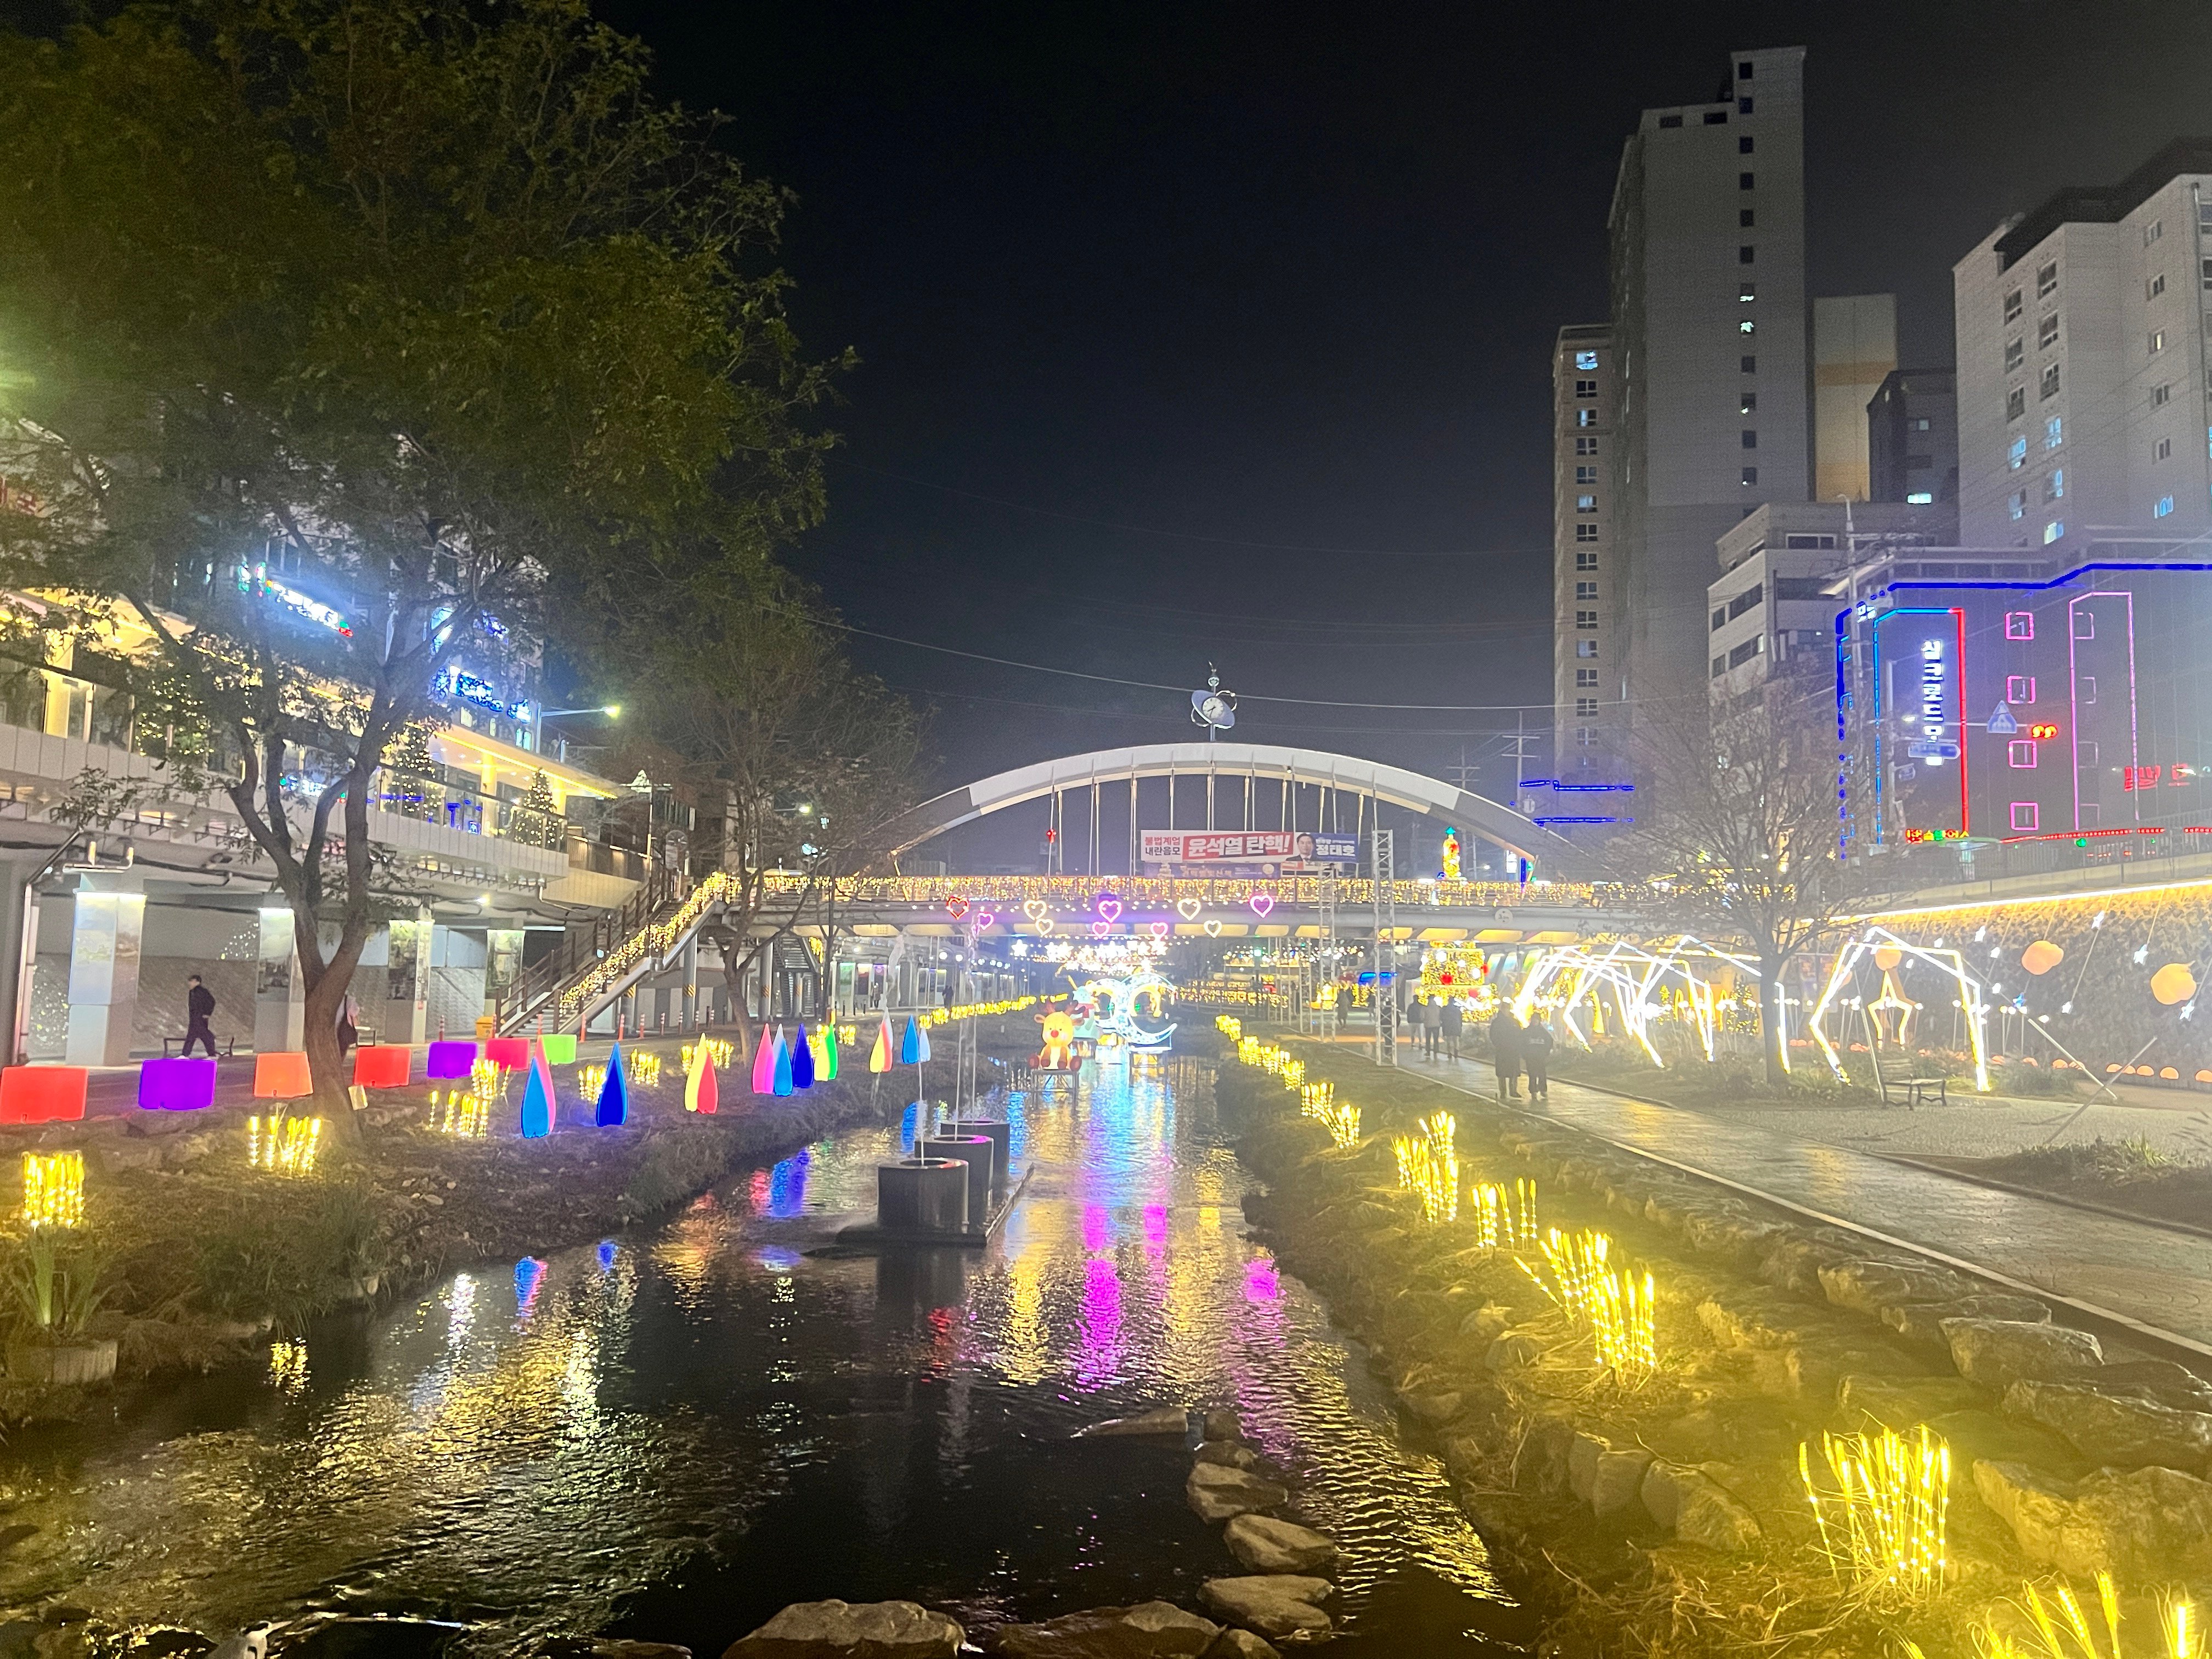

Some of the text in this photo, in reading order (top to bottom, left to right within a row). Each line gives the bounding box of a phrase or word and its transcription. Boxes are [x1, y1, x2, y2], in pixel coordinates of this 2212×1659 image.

[1145, 847, 1181, 856] 내란음모
[1188, 835, 1290, 857] 윤석열 탄핵!
[1316, 845, 1356, 857] 정태호
